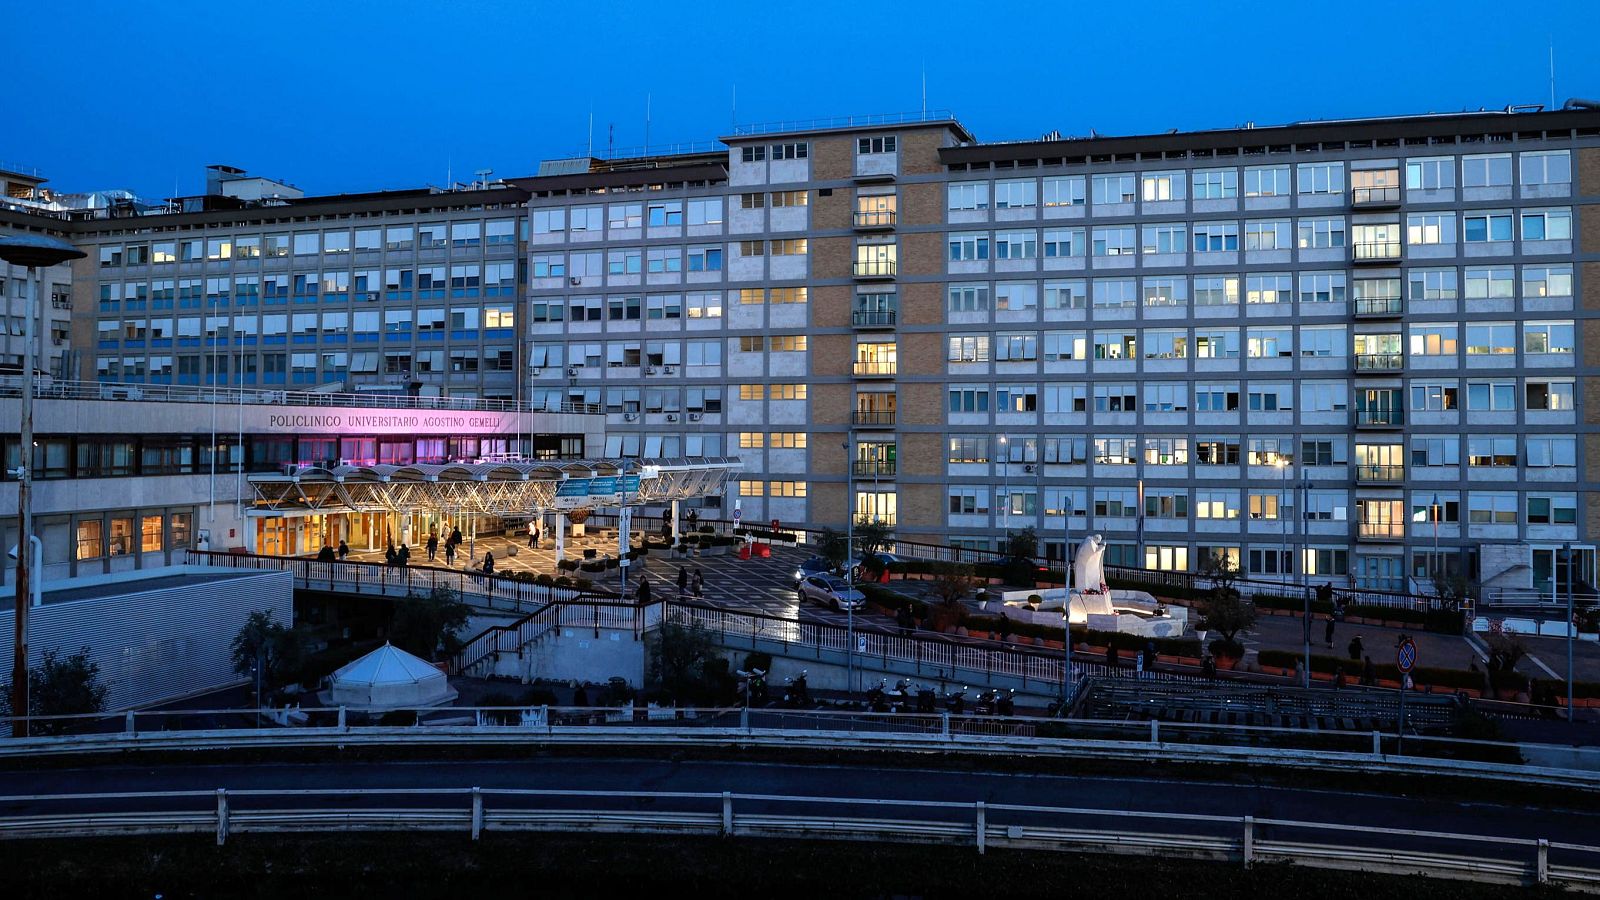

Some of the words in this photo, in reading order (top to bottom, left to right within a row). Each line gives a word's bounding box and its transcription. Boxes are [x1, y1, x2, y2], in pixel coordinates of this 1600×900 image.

[270, 415, 341, 427] POLICLINICO
[348, 416, 419, 427] UNIVERSITARIO
[423, 417, 464, 428] AGOSTINO
[469, 417, 500, 428] GEMELLI
